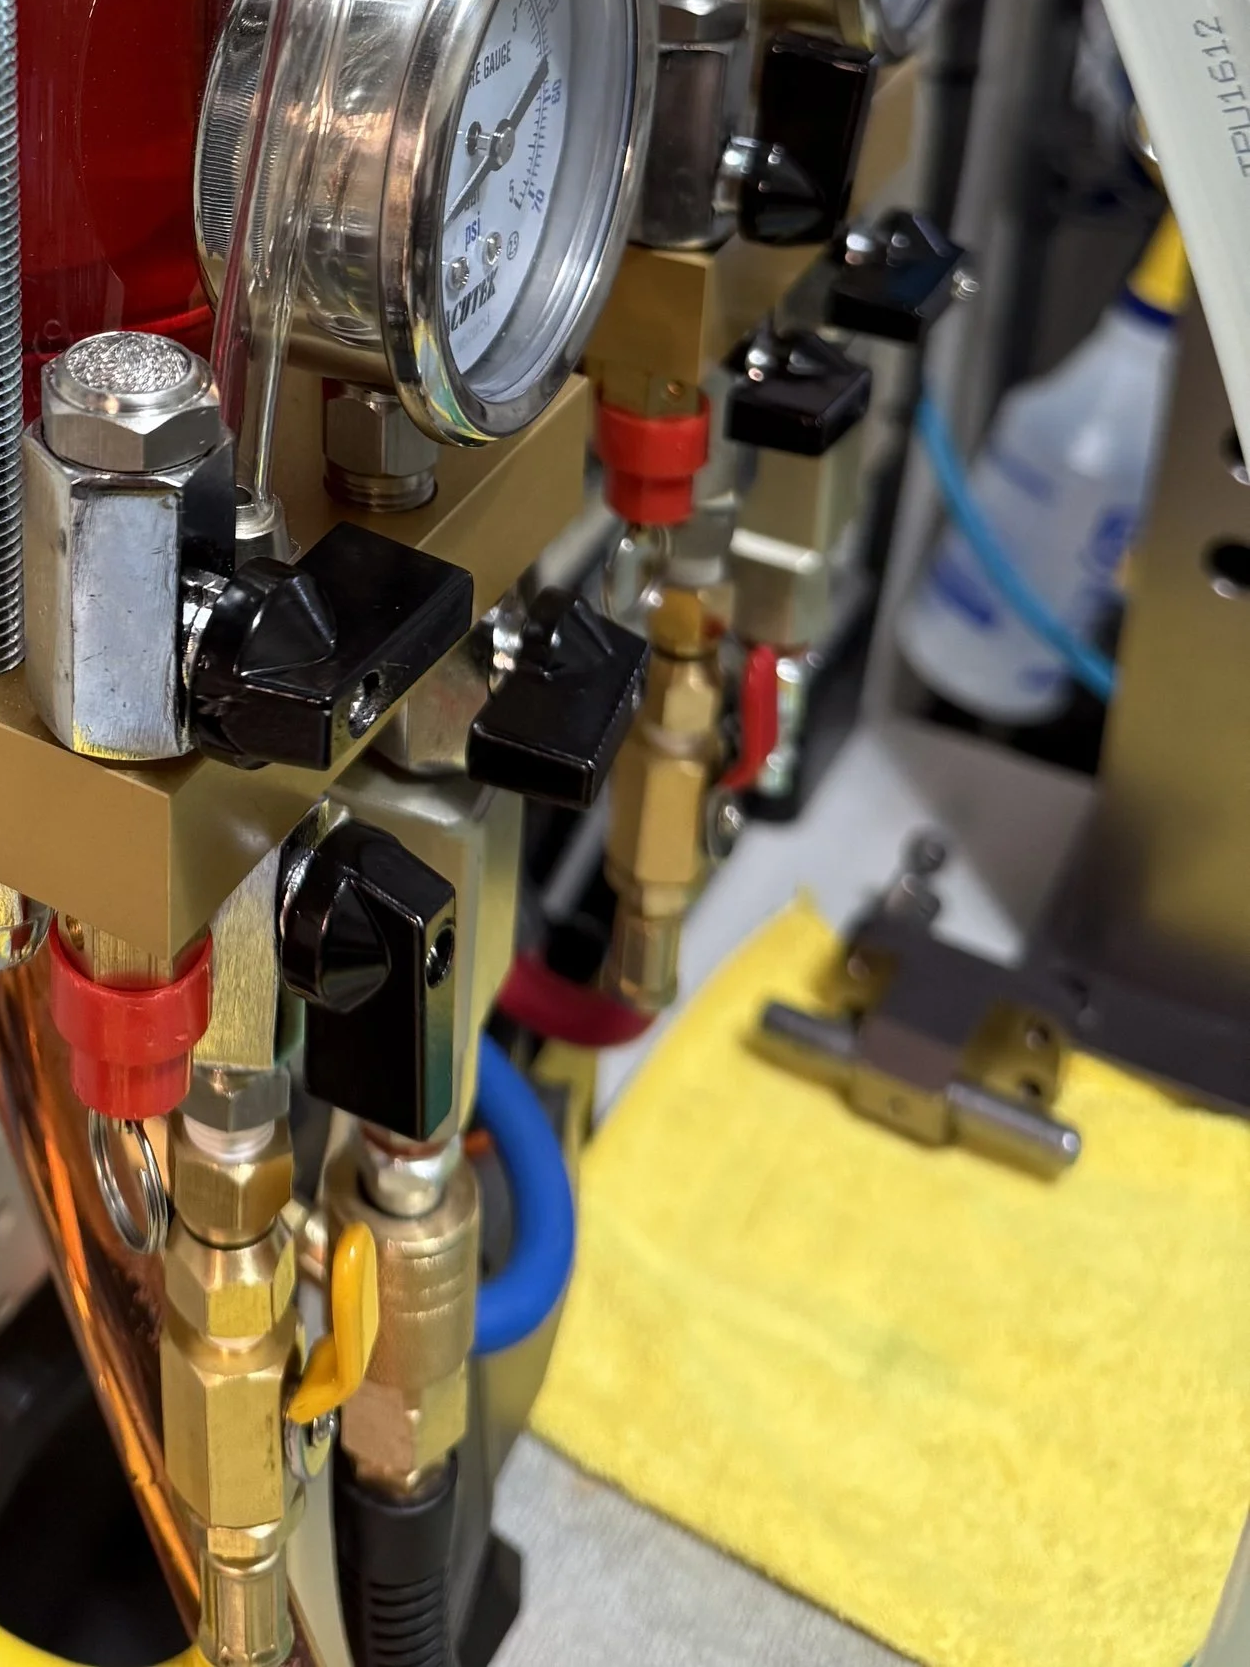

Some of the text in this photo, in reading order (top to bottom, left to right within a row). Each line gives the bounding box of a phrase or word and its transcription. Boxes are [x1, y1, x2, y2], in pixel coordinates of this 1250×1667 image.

[482, 39, 512, 80] GAUGE
[1193, 16, 1250, 177] TPU1612
[465, 210, 481, 252] psi
